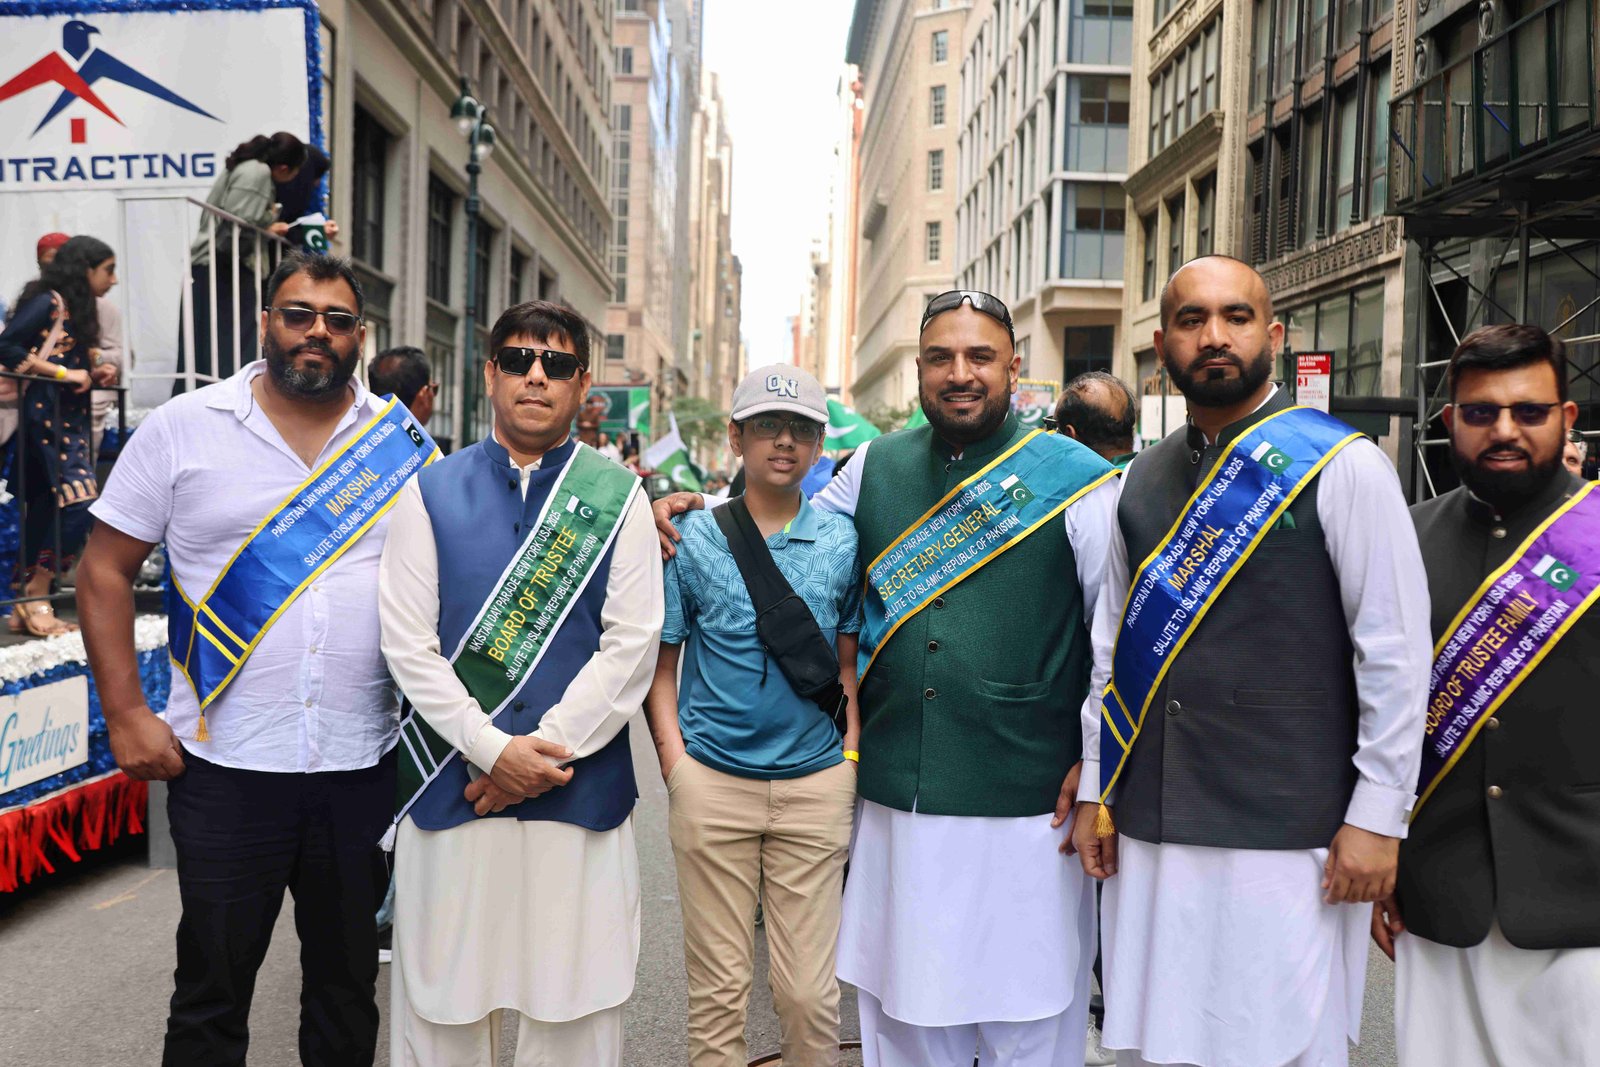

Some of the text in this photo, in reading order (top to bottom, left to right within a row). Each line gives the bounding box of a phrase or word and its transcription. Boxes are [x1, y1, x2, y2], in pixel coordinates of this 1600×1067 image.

[0, 152, 215, 183] TRACTING
[766, 374, 798, 398] ON
[271, 420, 397, 538] PAKISTAN DAY PARADE NEW YORK USA 2025
[303, 451, 422, 567] SALUTE TO ISLAMIC REPUBLIC OF PAKISTAN
[325, 467, 381, 517] MARSHAL
[889, 547, 905, 565] DAY
[902, 527, 933, 554] PARADE
[928, 514, 947, 534] NEW
[943, 499, 965, 521] YORK
[960, 489, 980, 506] USA
[973, 479, 993, 497] 2025
[469, 509, 561, 653] AKISTAN DAY PARADE NEW YORK USA 2025
[487, 525, 577, 662] BOARD OF TRUSTEE
[877, 500, 1003, 601] SECRETARY-GENERAL
[903, 589, 917, 603] TO
[913, 569, 944, 596] ISLAMIC
[941, 545, 979, 576] REPUBLIC
[975, 536, 987, 551] OF
[985, 513, 1021, 544] PAKISTAN
[1126, 457, 1245, 629] PAKISTAN DAY PARADE NEW YORK USA 2025
[1152, 481, 1283, 657] SALUTE TO ISLAMIC REPUBLIC OF PAKISTAN
[1167, 524, 1225, 591] MARSHAL
[505, 532, 599, 681] SALUTE TO ISLAMIC REPUBLIC OF PAKISTAN
[1445, 674, 1465, 697] OF
[1455, 626, 1509, 681] TRUSTEE
[1495, 589, 1540, 635] FAMILY
[1453, 621, 1477, 645] NEW
[1467, 601, 1495, 627] YORK
[1487, 584, 1510, 605] USA
[1500, 571, 1524, 590] 2025
[1435, 598, 1571, 758] ALUTE TO ISLAMIC REPUBLIC OF PAKISTAN
[0, 705, 81, 787] Greetings
